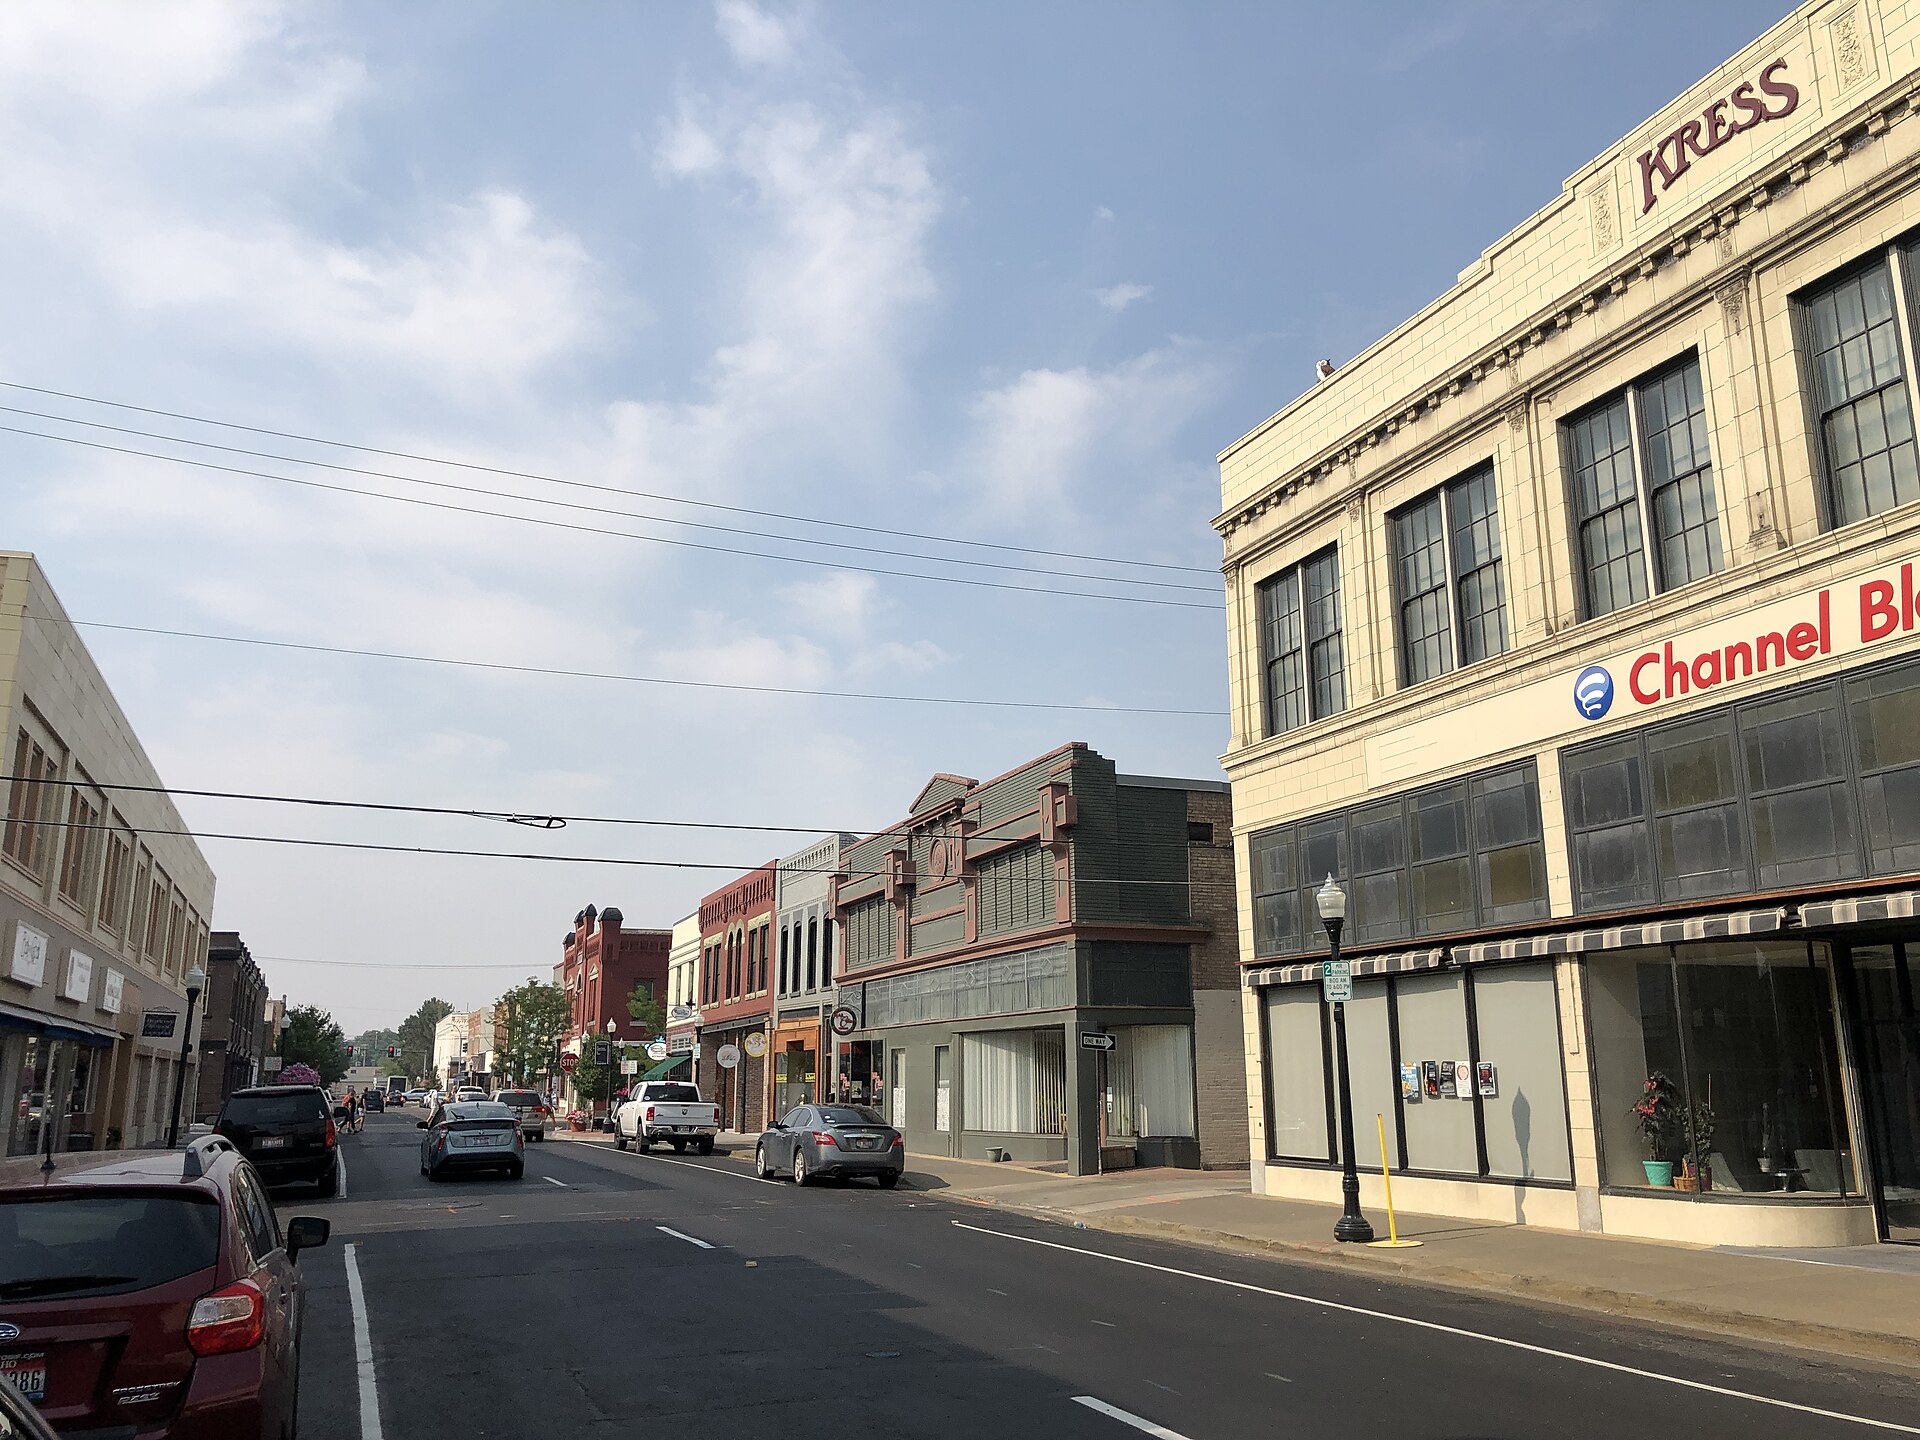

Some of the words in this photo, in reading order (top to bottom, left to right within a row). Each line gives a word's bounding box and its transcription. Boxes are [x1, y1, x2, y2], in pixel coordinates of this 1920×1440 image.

[1637, 57, 1799, 214] KRESS
[1629, 590, 1832, 705] Channel
[1859, 562, 1920, 644] Bl
[1325, 965, 1331, 975] 2
[562, 1059, 578, 1067] STOP
